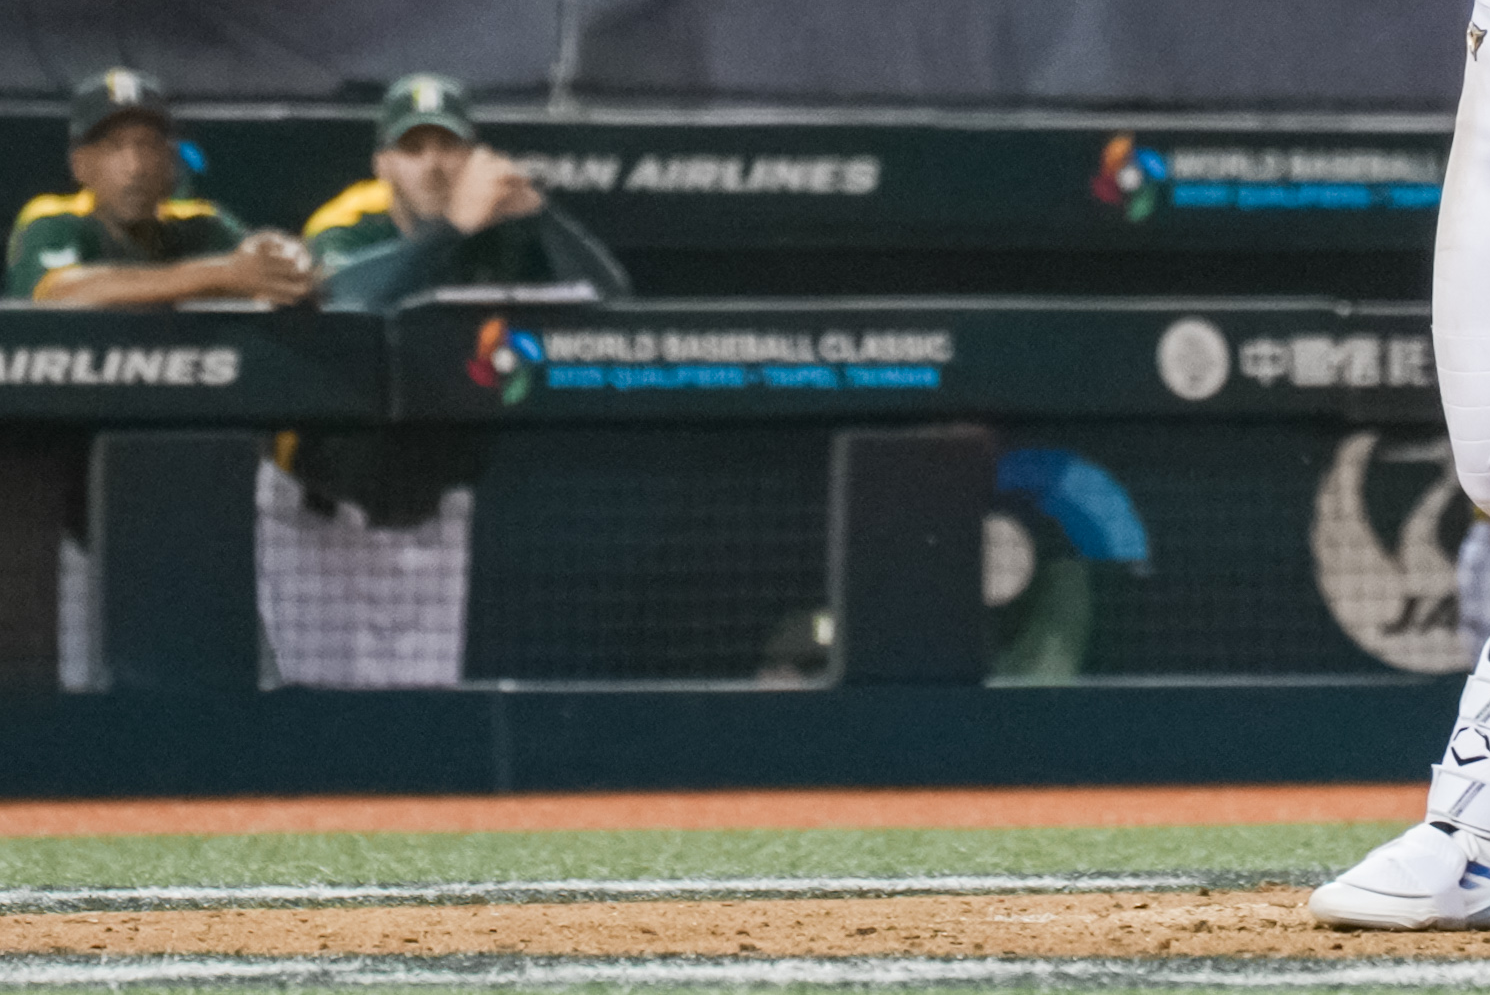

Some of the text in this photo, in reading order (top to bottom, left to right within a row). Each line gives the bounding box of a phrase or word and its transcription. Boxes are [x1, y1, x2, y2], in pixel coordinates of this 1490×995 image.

[624, 154, 881, 195] AIRLINES
[544, 331, 953, 364] WORLD BASEBALL CLASSIC
